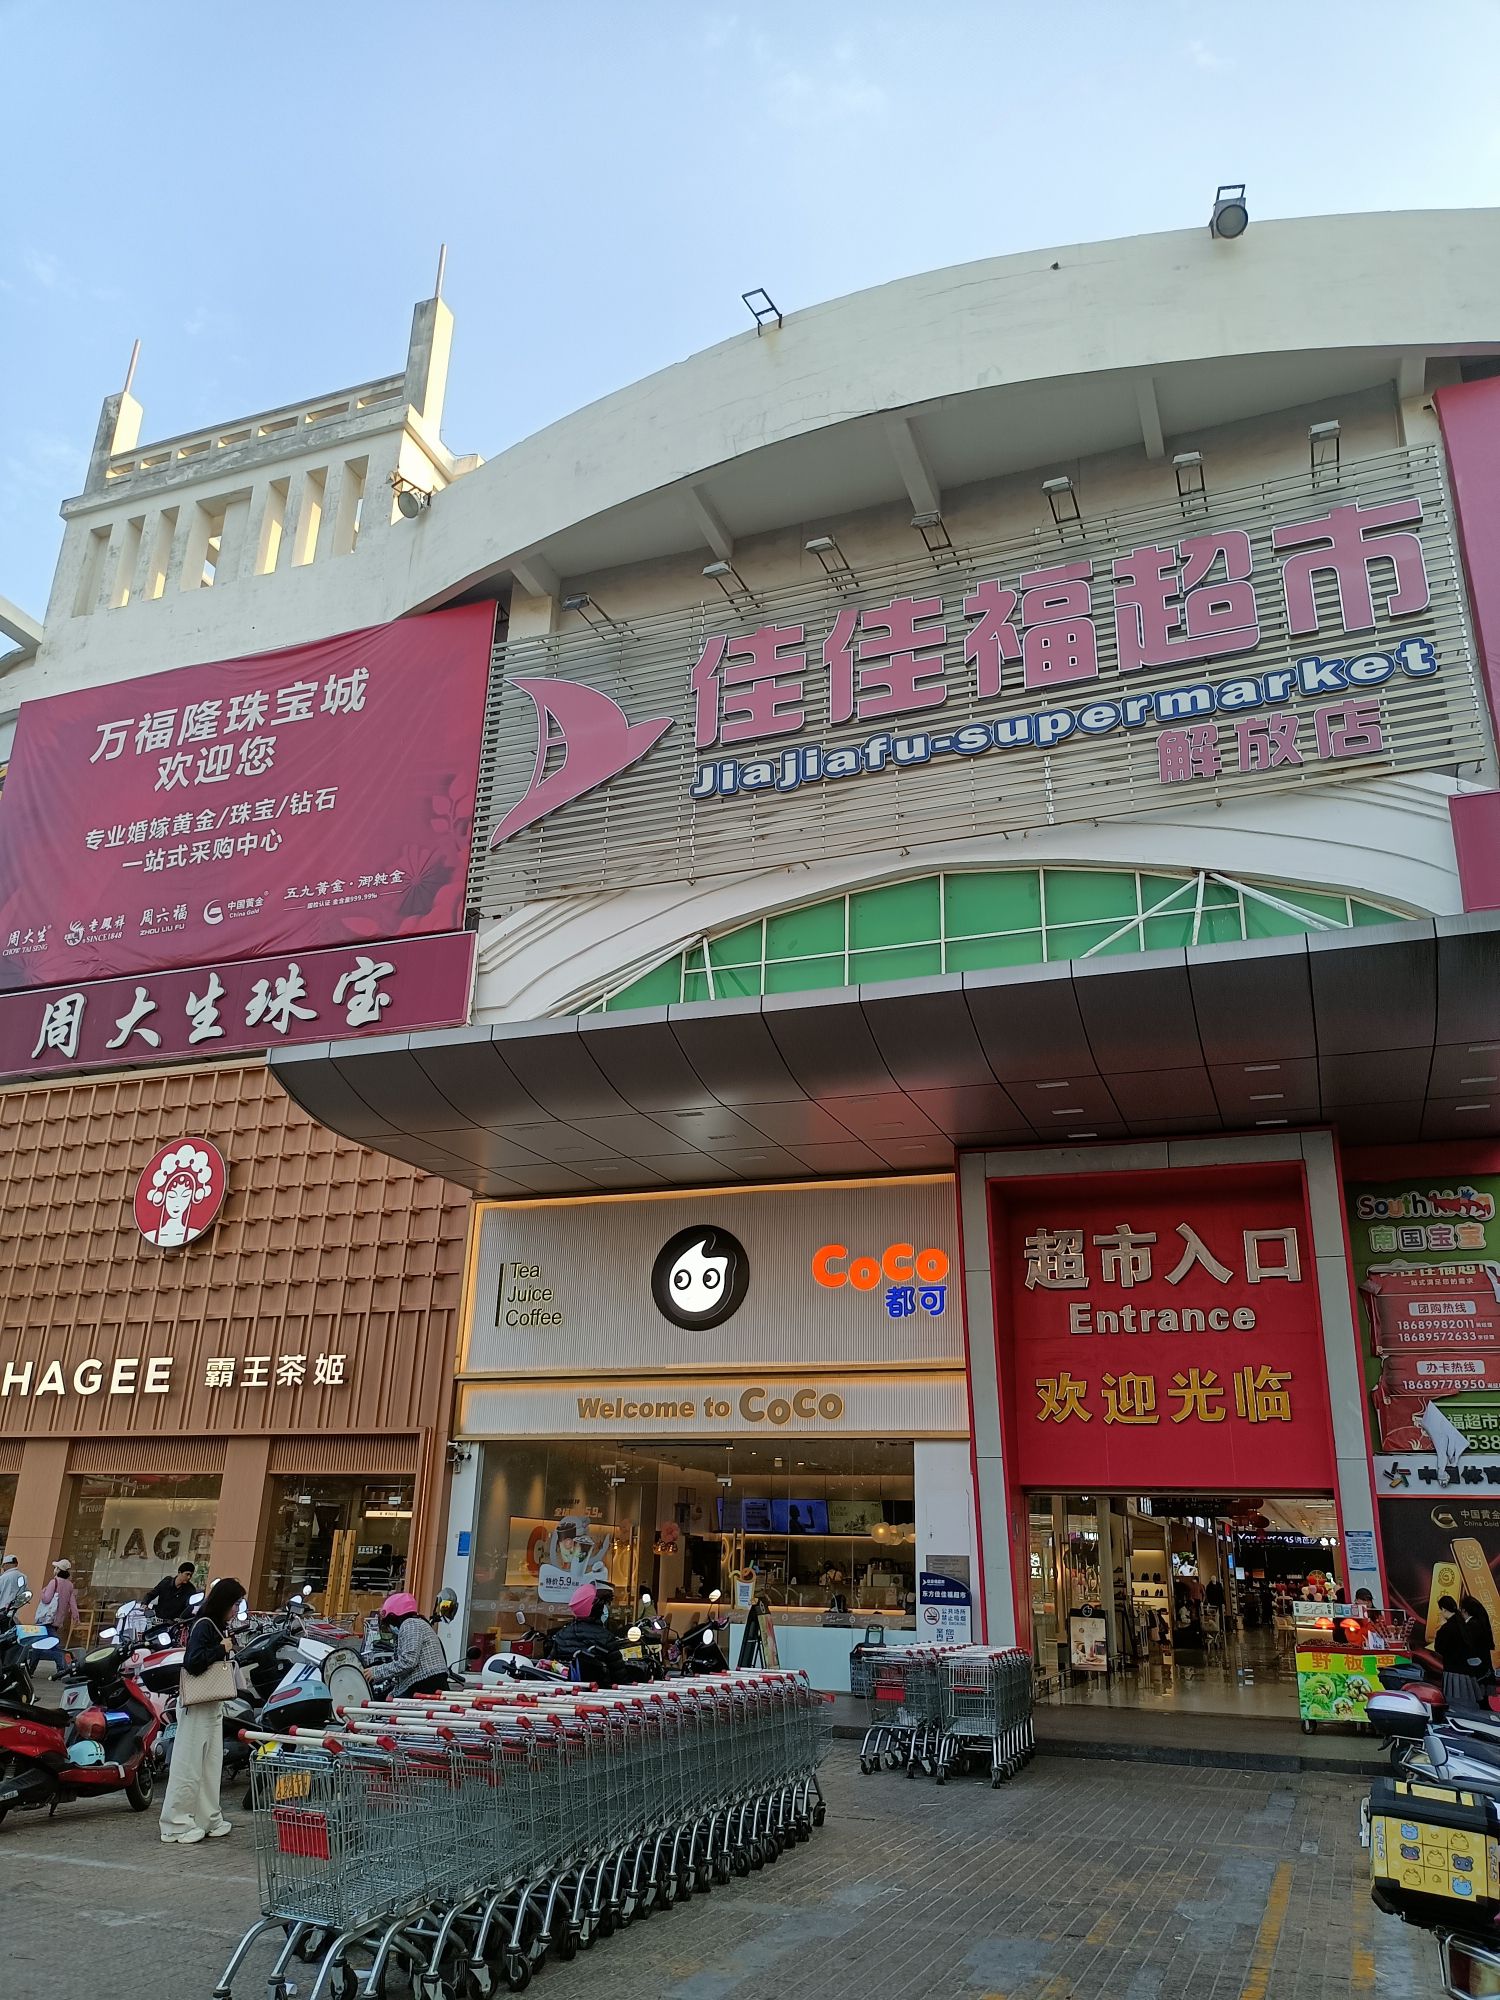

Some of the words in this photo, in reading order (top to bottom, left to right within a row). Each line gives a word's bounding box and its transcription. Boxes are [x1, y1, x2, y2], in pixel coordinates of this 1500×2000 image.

[691, 497, 1432, 751] 佳佳福超市
[89, 667, 371, 765] 万福隆珠宝城
[690, 637, 1440, 799] Jiajiafu-supermarket
[1157, 698, 1386, 786] 解放店
[153, 735, 278, 793] 欢迎您
[84, 786, 339, 851] 专业婚嫁黄金/珠宝/钻石
[122, 829, 283, 874] 一站式采购中心
[139, 903, 188, 927] 周六福
[227, 896, 264, 911] 中国黄金
[229, 911, 246, 919] China
[247, 908, 260, 916] Gold
[7, 925, 48, 947] 周大生
[139, 927, 160, 936] ZHOU
[161, 925, 173, 934] LIU
[174, 923, 185, 931] FU
[32, 956, 397, 1060] 周大生珠宝
[1358, 1191, 1428, 1218] South
[1023, 1223, 1302, 1291] 超市入口
[510, 1262, 541, 1279] Tea
[507, 1285, 553, 1303] Juice
[885, 1285, 947, 1318] 都可
[505, 1309, 562, 1327] Coffee
[1069, 1303, 1256, 1334] Entrance
[1418, 1303, 1467, 1314] 团购热线
[1397, 1319, 1475, 1330] 18689982011
[1398, 1331, 1477, 1342] 18689572633
[204, 1353, 347, 1389] 霸王茶姬
[1425, 1361, 1476, 1373] 办卡热线
[1035, 1364, 1293, 1424] 欢迎光临
[1403, 1379, 1485, 1390] 18689778950
[577, 1397, 695, 1421] Welcome
[704, 1397, 731, 1418] to
